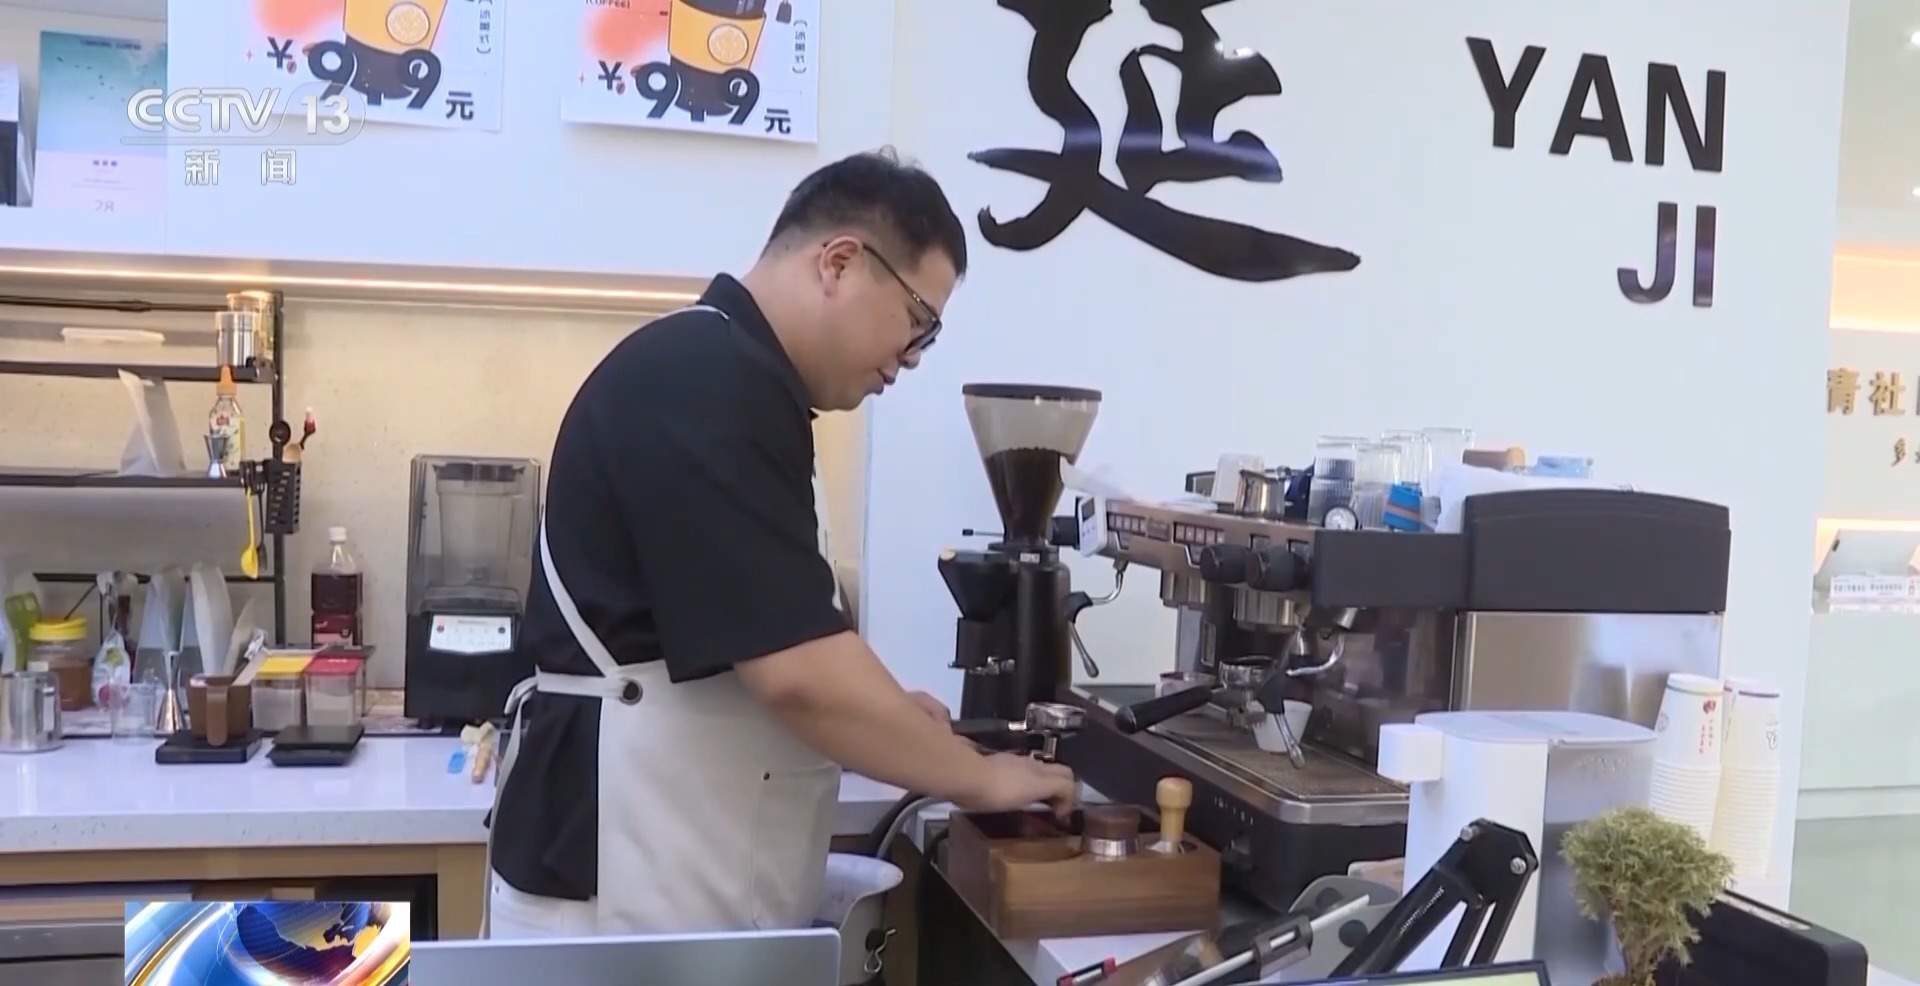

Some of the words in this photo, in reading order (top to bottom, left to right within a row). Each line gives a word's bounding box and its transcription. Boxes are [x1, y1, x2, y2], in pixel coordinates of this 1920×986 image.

[967, 0, 1361, 282] 延
[1465, 36, 1726, 172] YAN
[1617, 201, 1716, 307] JI
[1826, 367, 1920, 415] 青社
